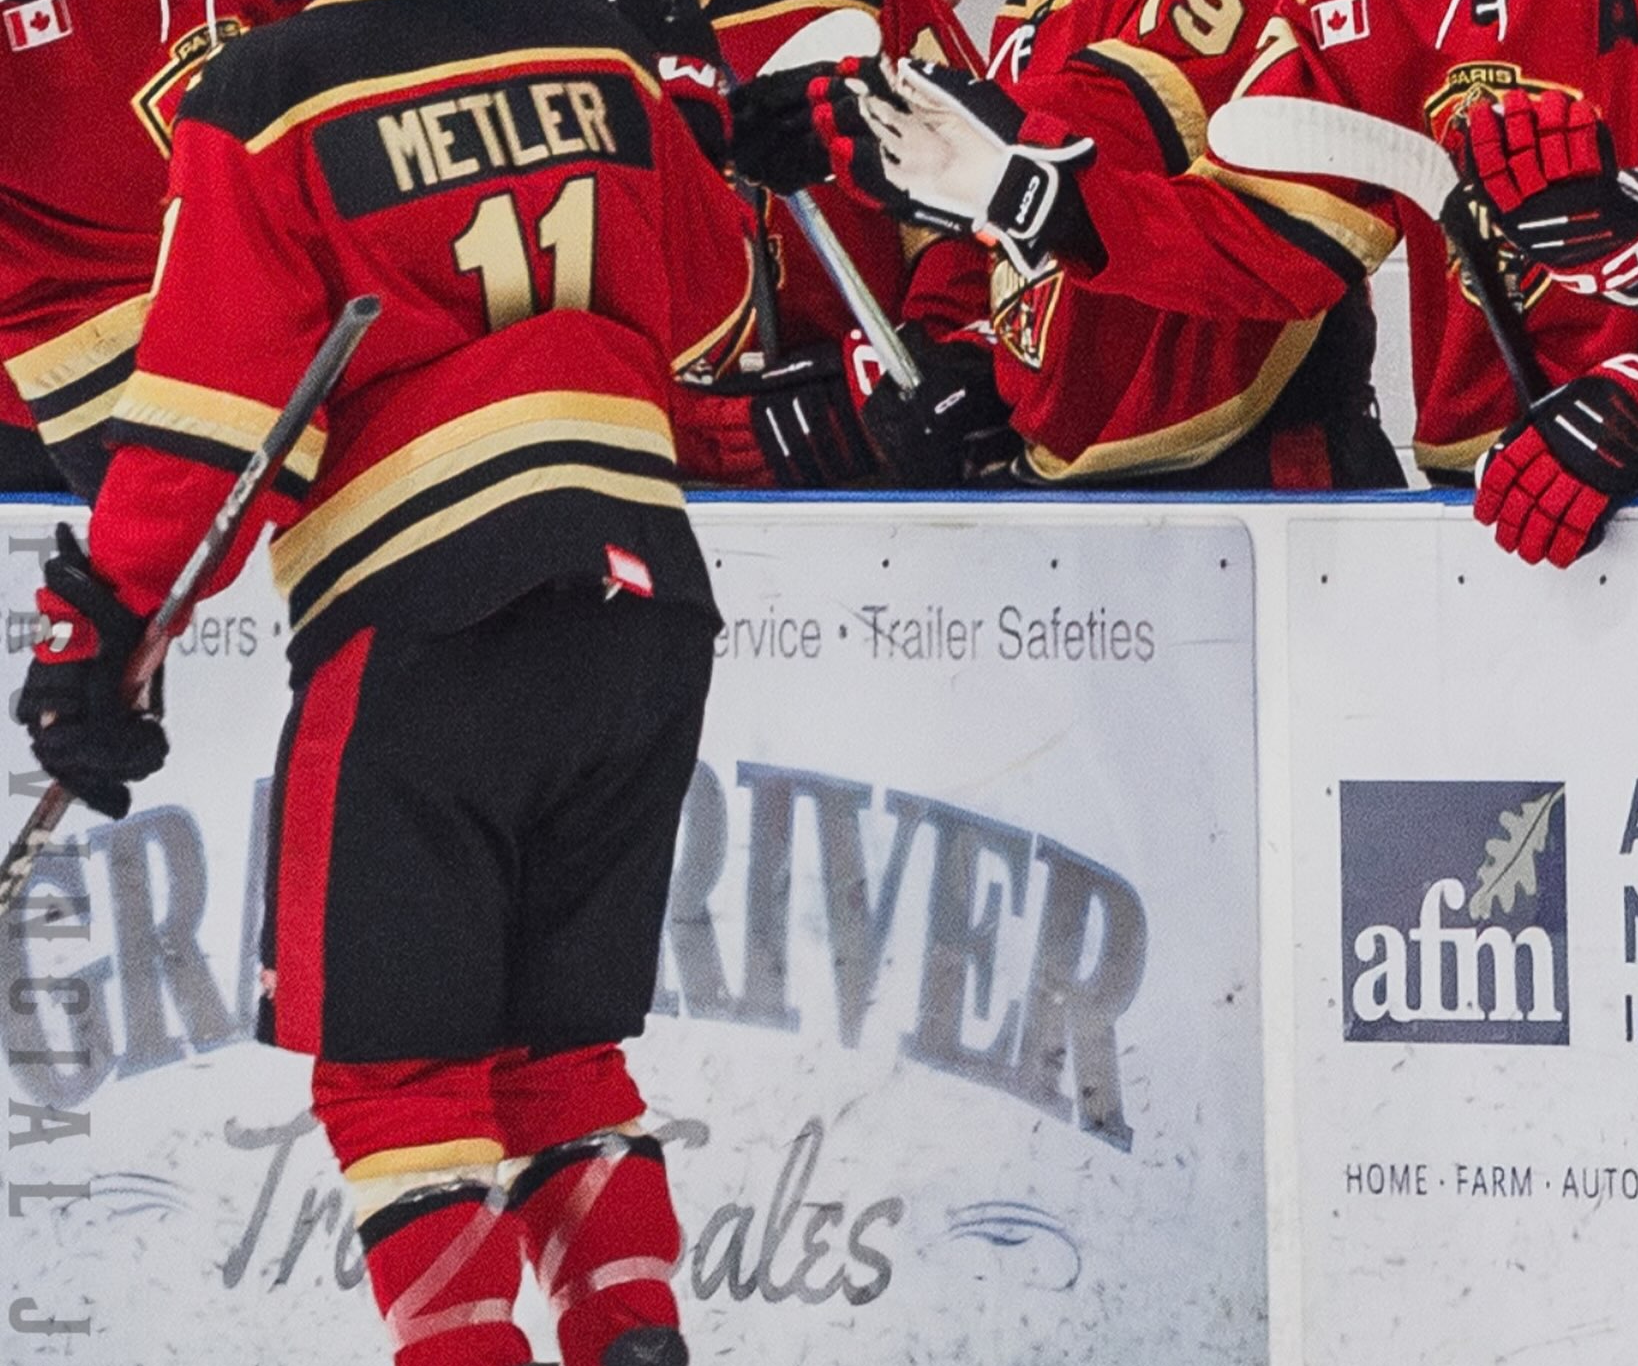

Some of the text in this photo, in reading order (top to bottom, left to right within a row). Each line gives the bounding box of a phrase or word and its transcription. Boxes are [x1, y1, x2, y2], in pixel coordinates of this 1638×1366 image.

[377, 82, 618, 192] METLER
[452, 175, 597, 334] 11
[862, 605, 984, 660] Trailer
[998, 605, 1155, 662] Safeties
[1352, 877, 1563, 1023] afm
[1344, 1162, 1428, 1196] HOME
[1455, 1165, 1533, 1199] FARM
